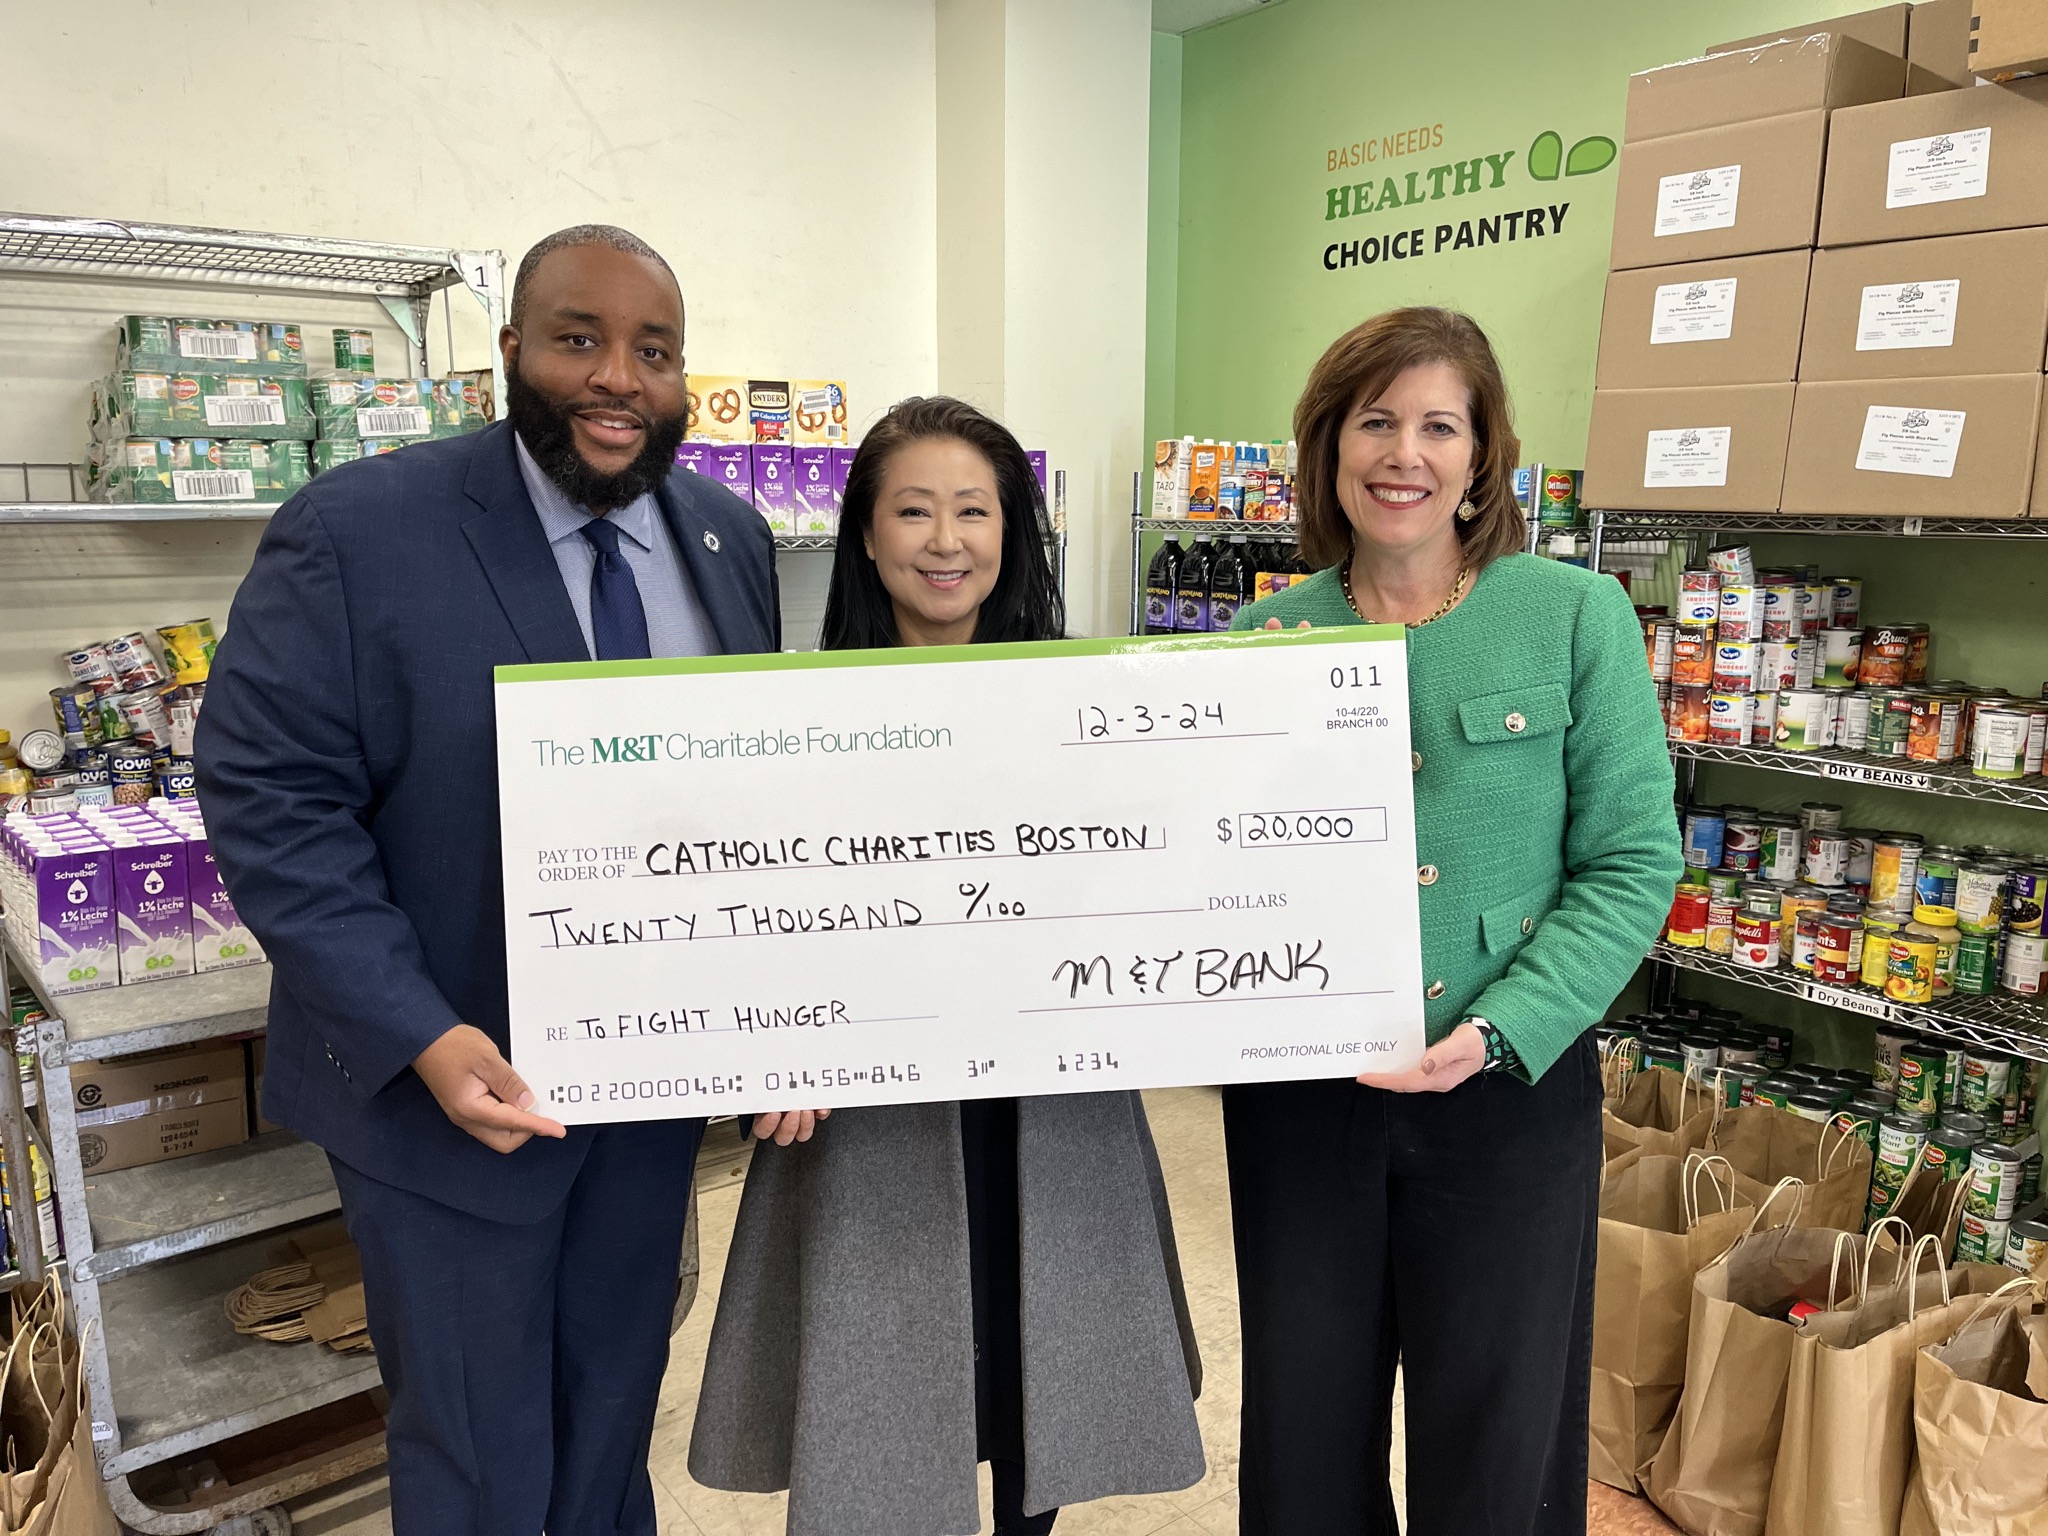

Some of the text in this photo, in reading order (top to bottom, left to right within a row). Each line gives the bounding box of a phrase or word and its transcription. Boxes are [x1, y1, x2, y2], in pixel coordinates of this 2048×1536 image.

[1327, 123, 1444, 172] BASIC NEEDS
[1324, 150, 1516, 221] HEALTHY
[1323, 202, 1571, 270] CHOICE PANTRY
[475, 266, 489, 287] 1
[752, 393, 786, 403] SNYDER'S
[678, 453, 703, 461] Schreiber
[718, 455, 743, 463] Schreiber
[760, 455, 783, 463] Schreiber
[1520, 472, 1530, 483] 12
[763, 482, 774, 491] 1%
[805, 484, 816, 492] 1%
[1155, 481, 1175, 491] TAZO
[1555, 482, 1571, 490] Monte
[1909, 519, 1918, 532] 1
[1211, 592, 1238, 601] NORTHLAND
[1330, 665, 1382, 688] 011
[1335, 706, 1379, 718] 10-4/220
[1078, 702, 1223, 740] 12-3-24
[1326, 717, 1389, 730] BRANCH 00
[532, 723, 952, 767] The M&T Charitable Foundation
[114, 757, 152, 771] GOYA
[81, 770, 109, 783] OYA
[1829, 765, 1913, 786] DRY BEANS
[1217, 817, 1233, 844] $
[1248, 814, 1354, 842] 20,000
[537, 845, 638, 865] PAY TO THE
[646, 823, 1147, 876] CATHOLIC CHARITIES BOSTON
[131, 860, 173, 871] Schreiber
[54, 869, 98, 880] Schreiber
[538, 864, 626, 883] ORDER OF
[211, 891, 229, 903] 1%
[1208, 893, 1288, 911] DOLLARS
[138, 900, 184, 913] 1% Leche
[61, 910, 108, 923] 1% Leche
[529, 908, 697, 949] TWENTY
[717, 898, 922, 935] THOUSAND
[1195, 939, 1330, 997] BANK
[1893, 967, 1914, 976] Peaches
[1818, 990, 1880, 1015] Dry Beans
[618, 1008, 711, 1039] FIGHT
[734, 1000, 851, 1034] HUNGER
[546, 1026, 569, 1042] RE
[1240, 1040, 1398, 1060] PROMOTIONAL USE ONLY
[1057, 1052, 1119, 1073] 1234
[1880, 1128, 1902, 1141] Green
[1880, 1135, 1901, 1148] Giant
[2011, 1235, 2022, 1246] 365
